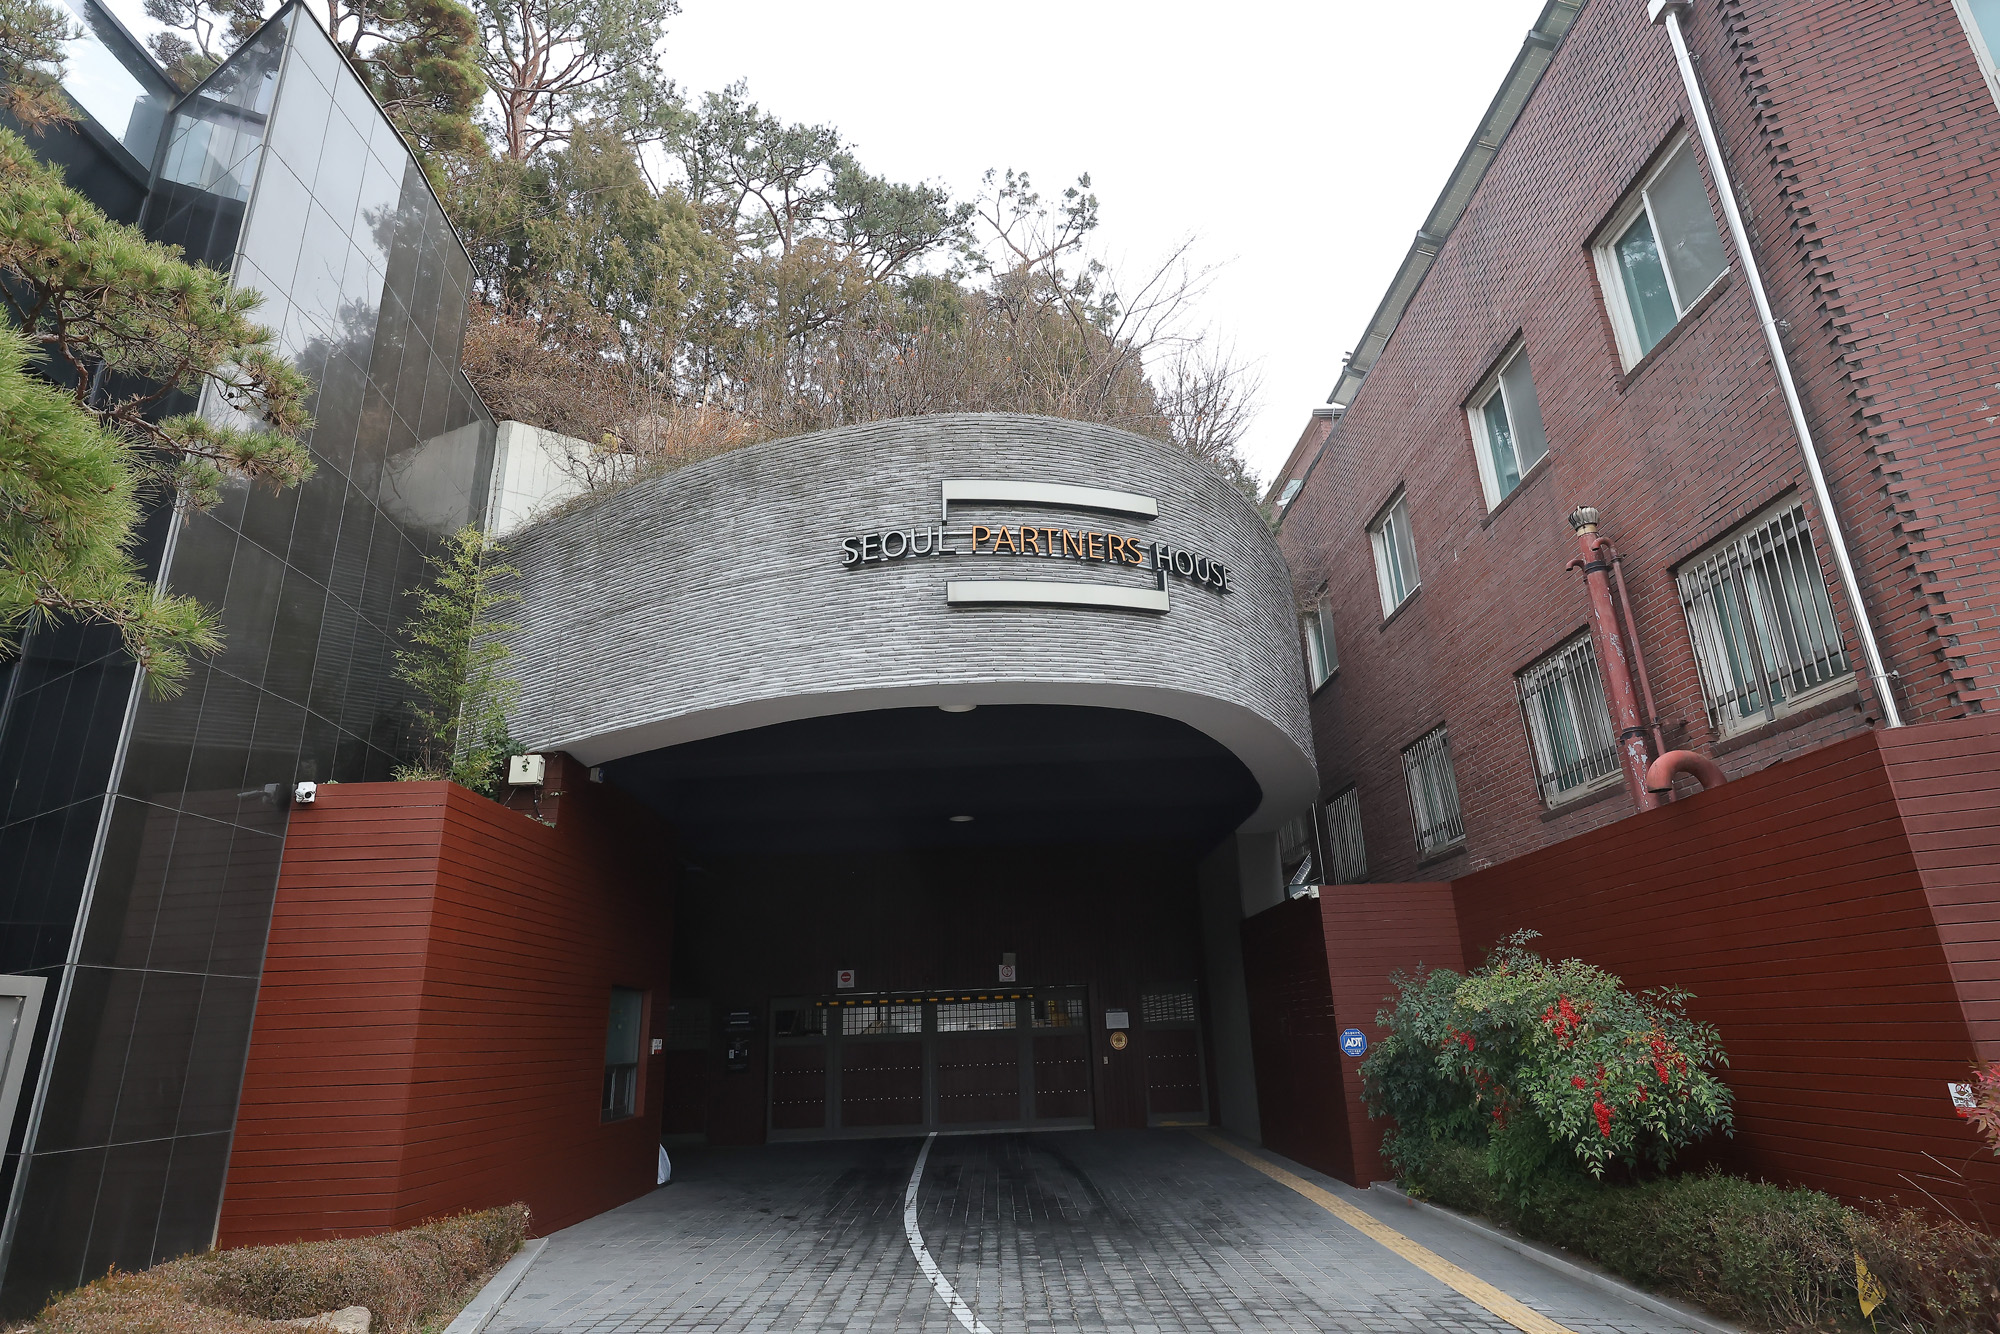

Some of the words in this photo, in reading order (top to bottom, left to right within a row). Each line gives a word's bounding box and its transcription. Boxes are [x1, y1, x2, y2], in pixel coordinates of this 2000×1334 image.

[841, 525, 956, 566] SEOUL
[971, 524, 1144, 565] PARTNERS
[1154, 541, 1235, 593] HOUSE
[1345, 1037, 1362, 1048] ADT
